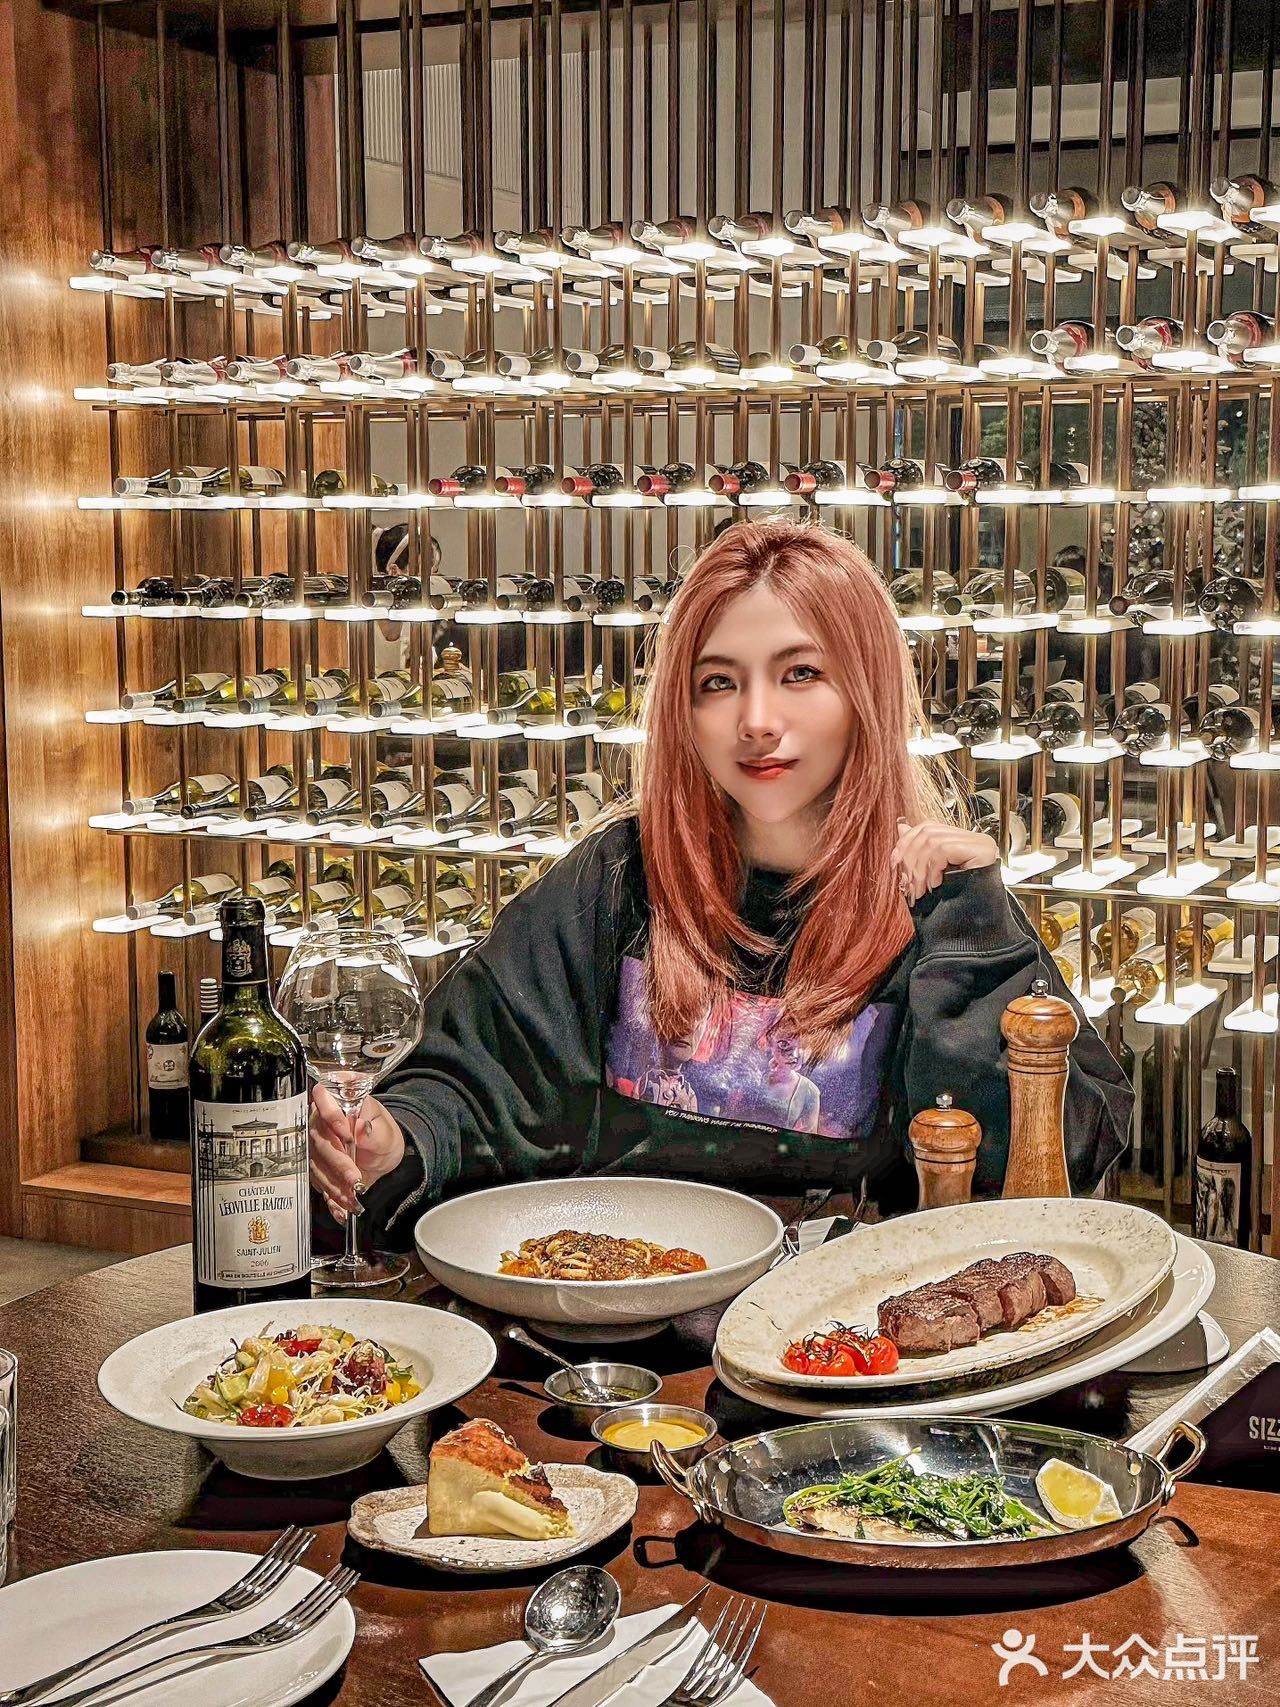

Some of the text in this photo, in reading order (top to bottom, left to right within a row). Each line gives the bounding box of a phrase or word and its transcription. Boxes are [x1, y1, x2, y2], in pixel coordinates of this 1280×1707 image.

[665, 1109, 679, 1117] YOU
[679, 1112, 710, 1124] THINKING
[219, 1197, 294, 1216] LÉOVILLE BARTON
[236, 1245, 281, 1256] SAINT-JULIEN
